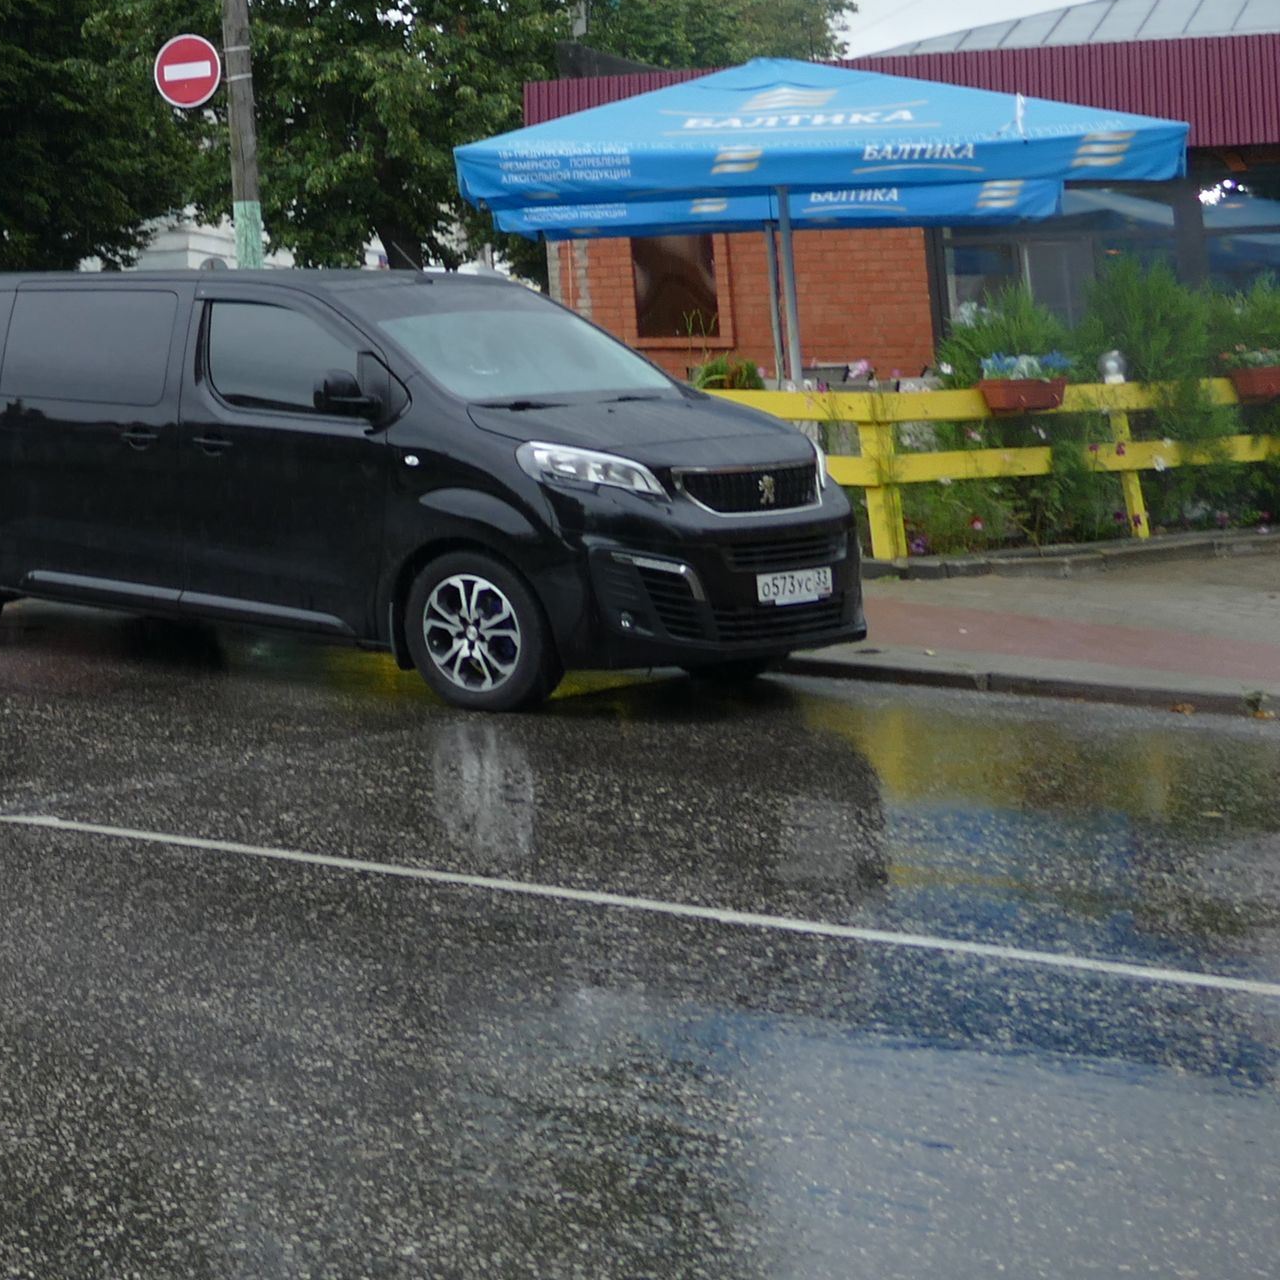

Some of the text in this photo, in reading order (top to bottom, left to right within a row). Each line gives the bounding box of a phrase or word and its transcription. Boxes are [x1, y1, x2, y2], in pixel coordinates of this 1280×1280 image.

[683, 109, 915, 129] БАЛТИКА
[863, 143, 974, 161] БАЛТИКА
[762, 569, 828, 597] О573УС 33
